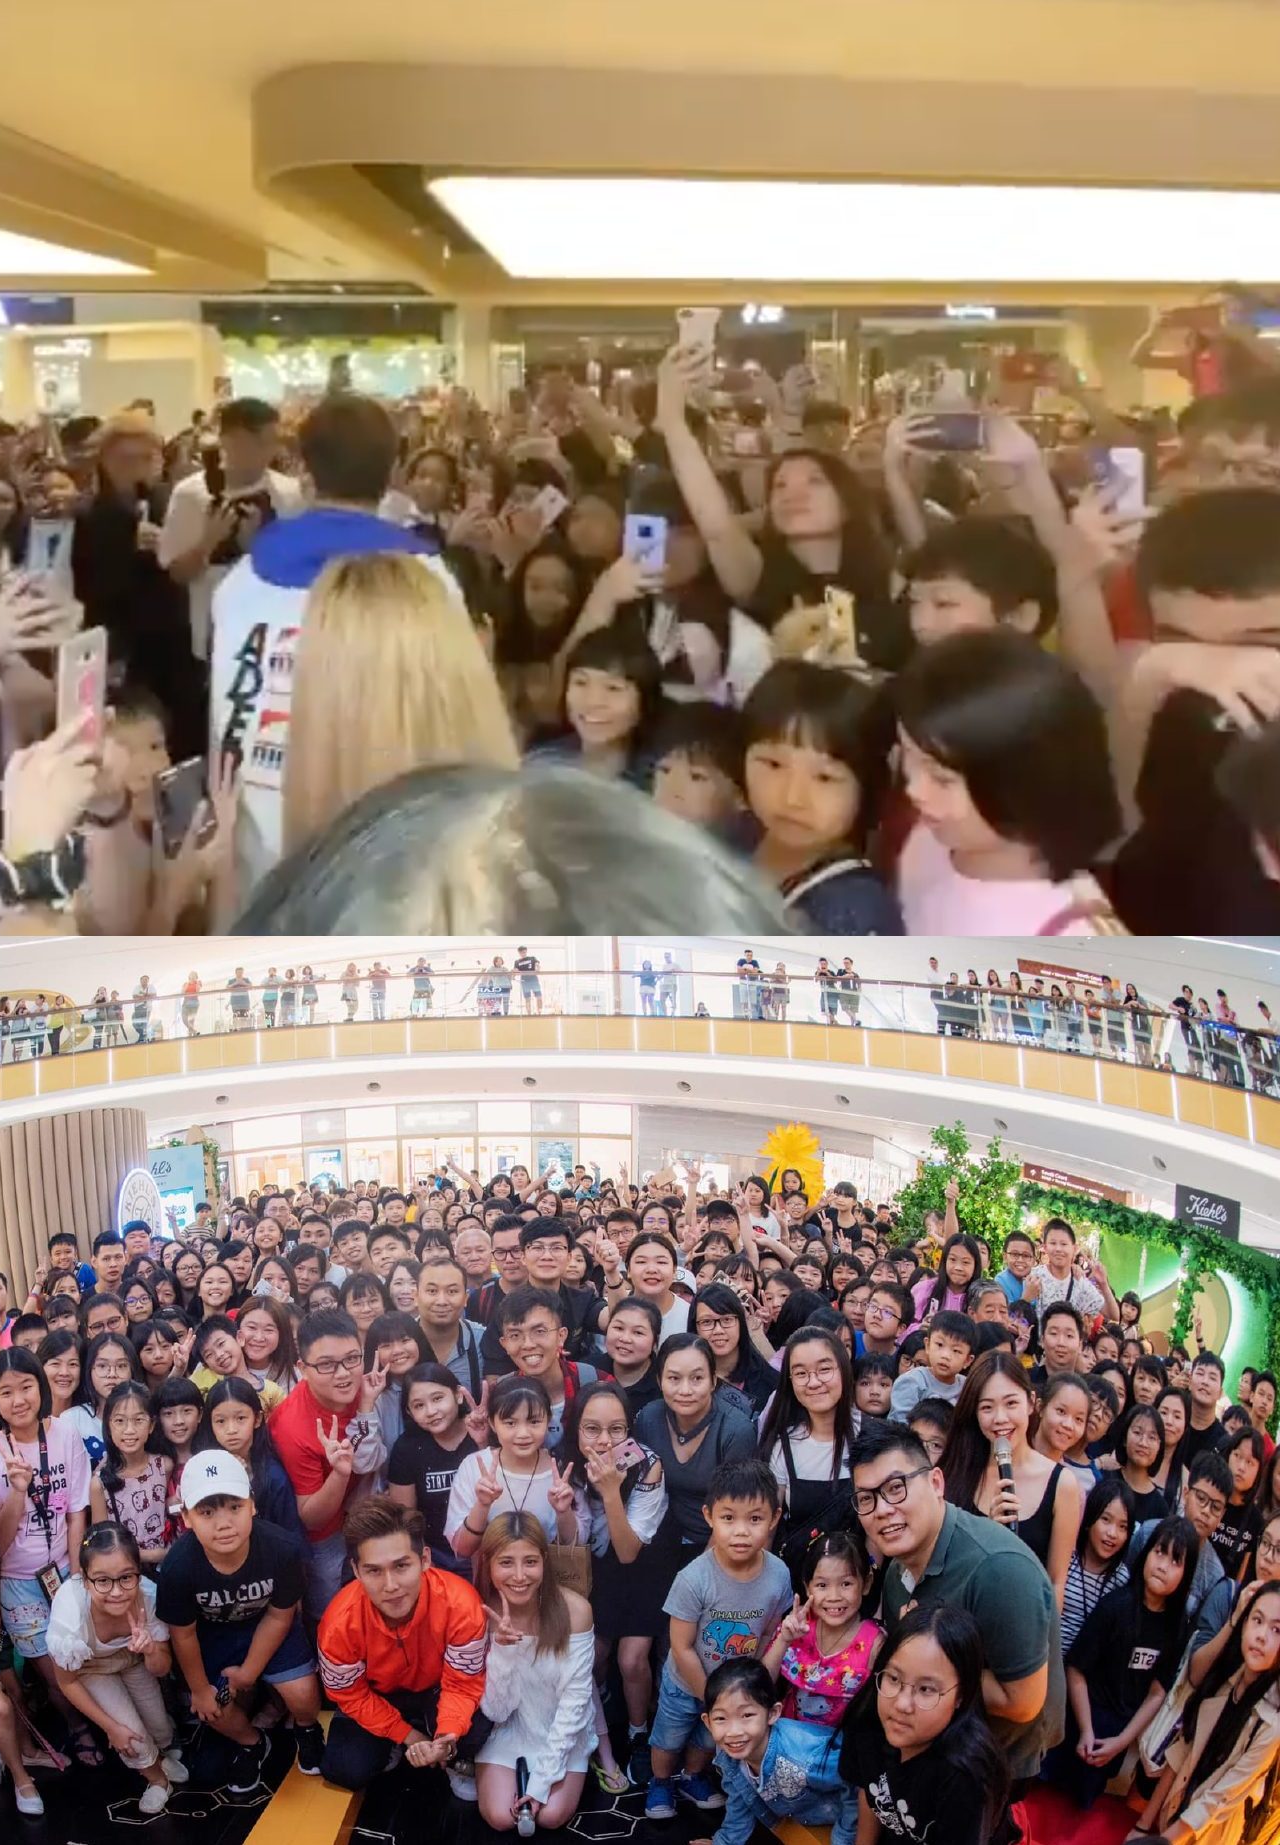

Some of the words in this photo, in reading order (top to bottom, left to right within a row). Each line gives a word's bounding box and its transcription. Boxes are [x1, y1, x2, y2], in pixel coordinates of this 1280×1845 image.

[1185, 1194, 1227, 1222] Kiehl's
[426, 1474, 446, 1489] STAY
[195, 1578, 274, 1607] FALCON
[710, 1608, 765, 1619] THAILAND
